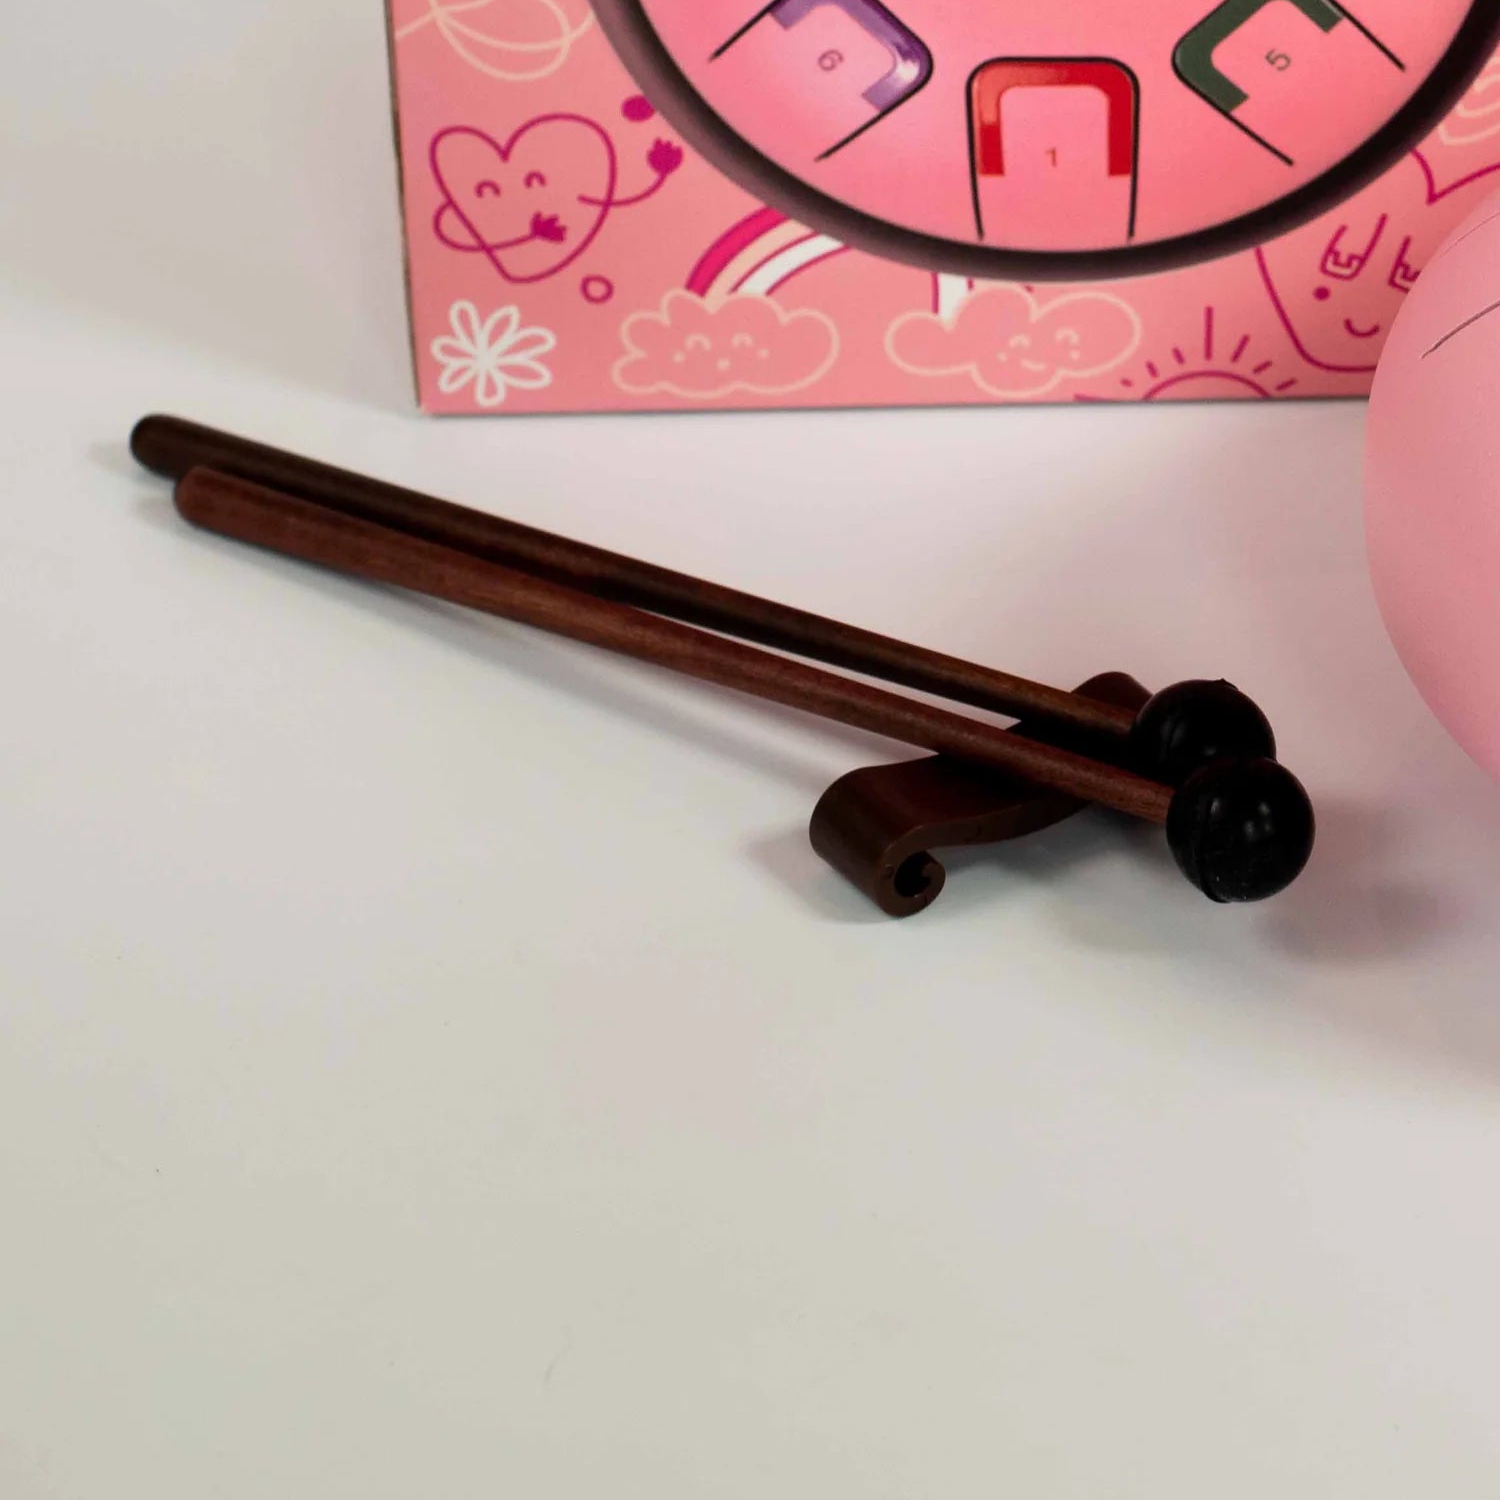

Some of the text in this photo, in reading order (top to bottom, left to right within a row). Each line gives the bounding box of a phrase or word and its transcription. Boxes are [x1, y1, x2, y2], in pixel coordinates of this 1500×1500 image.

[817, 48, 844, 73] 6
[1264, 47, 1292, 72] 5
[1044, 146, 1059, 168] 1
